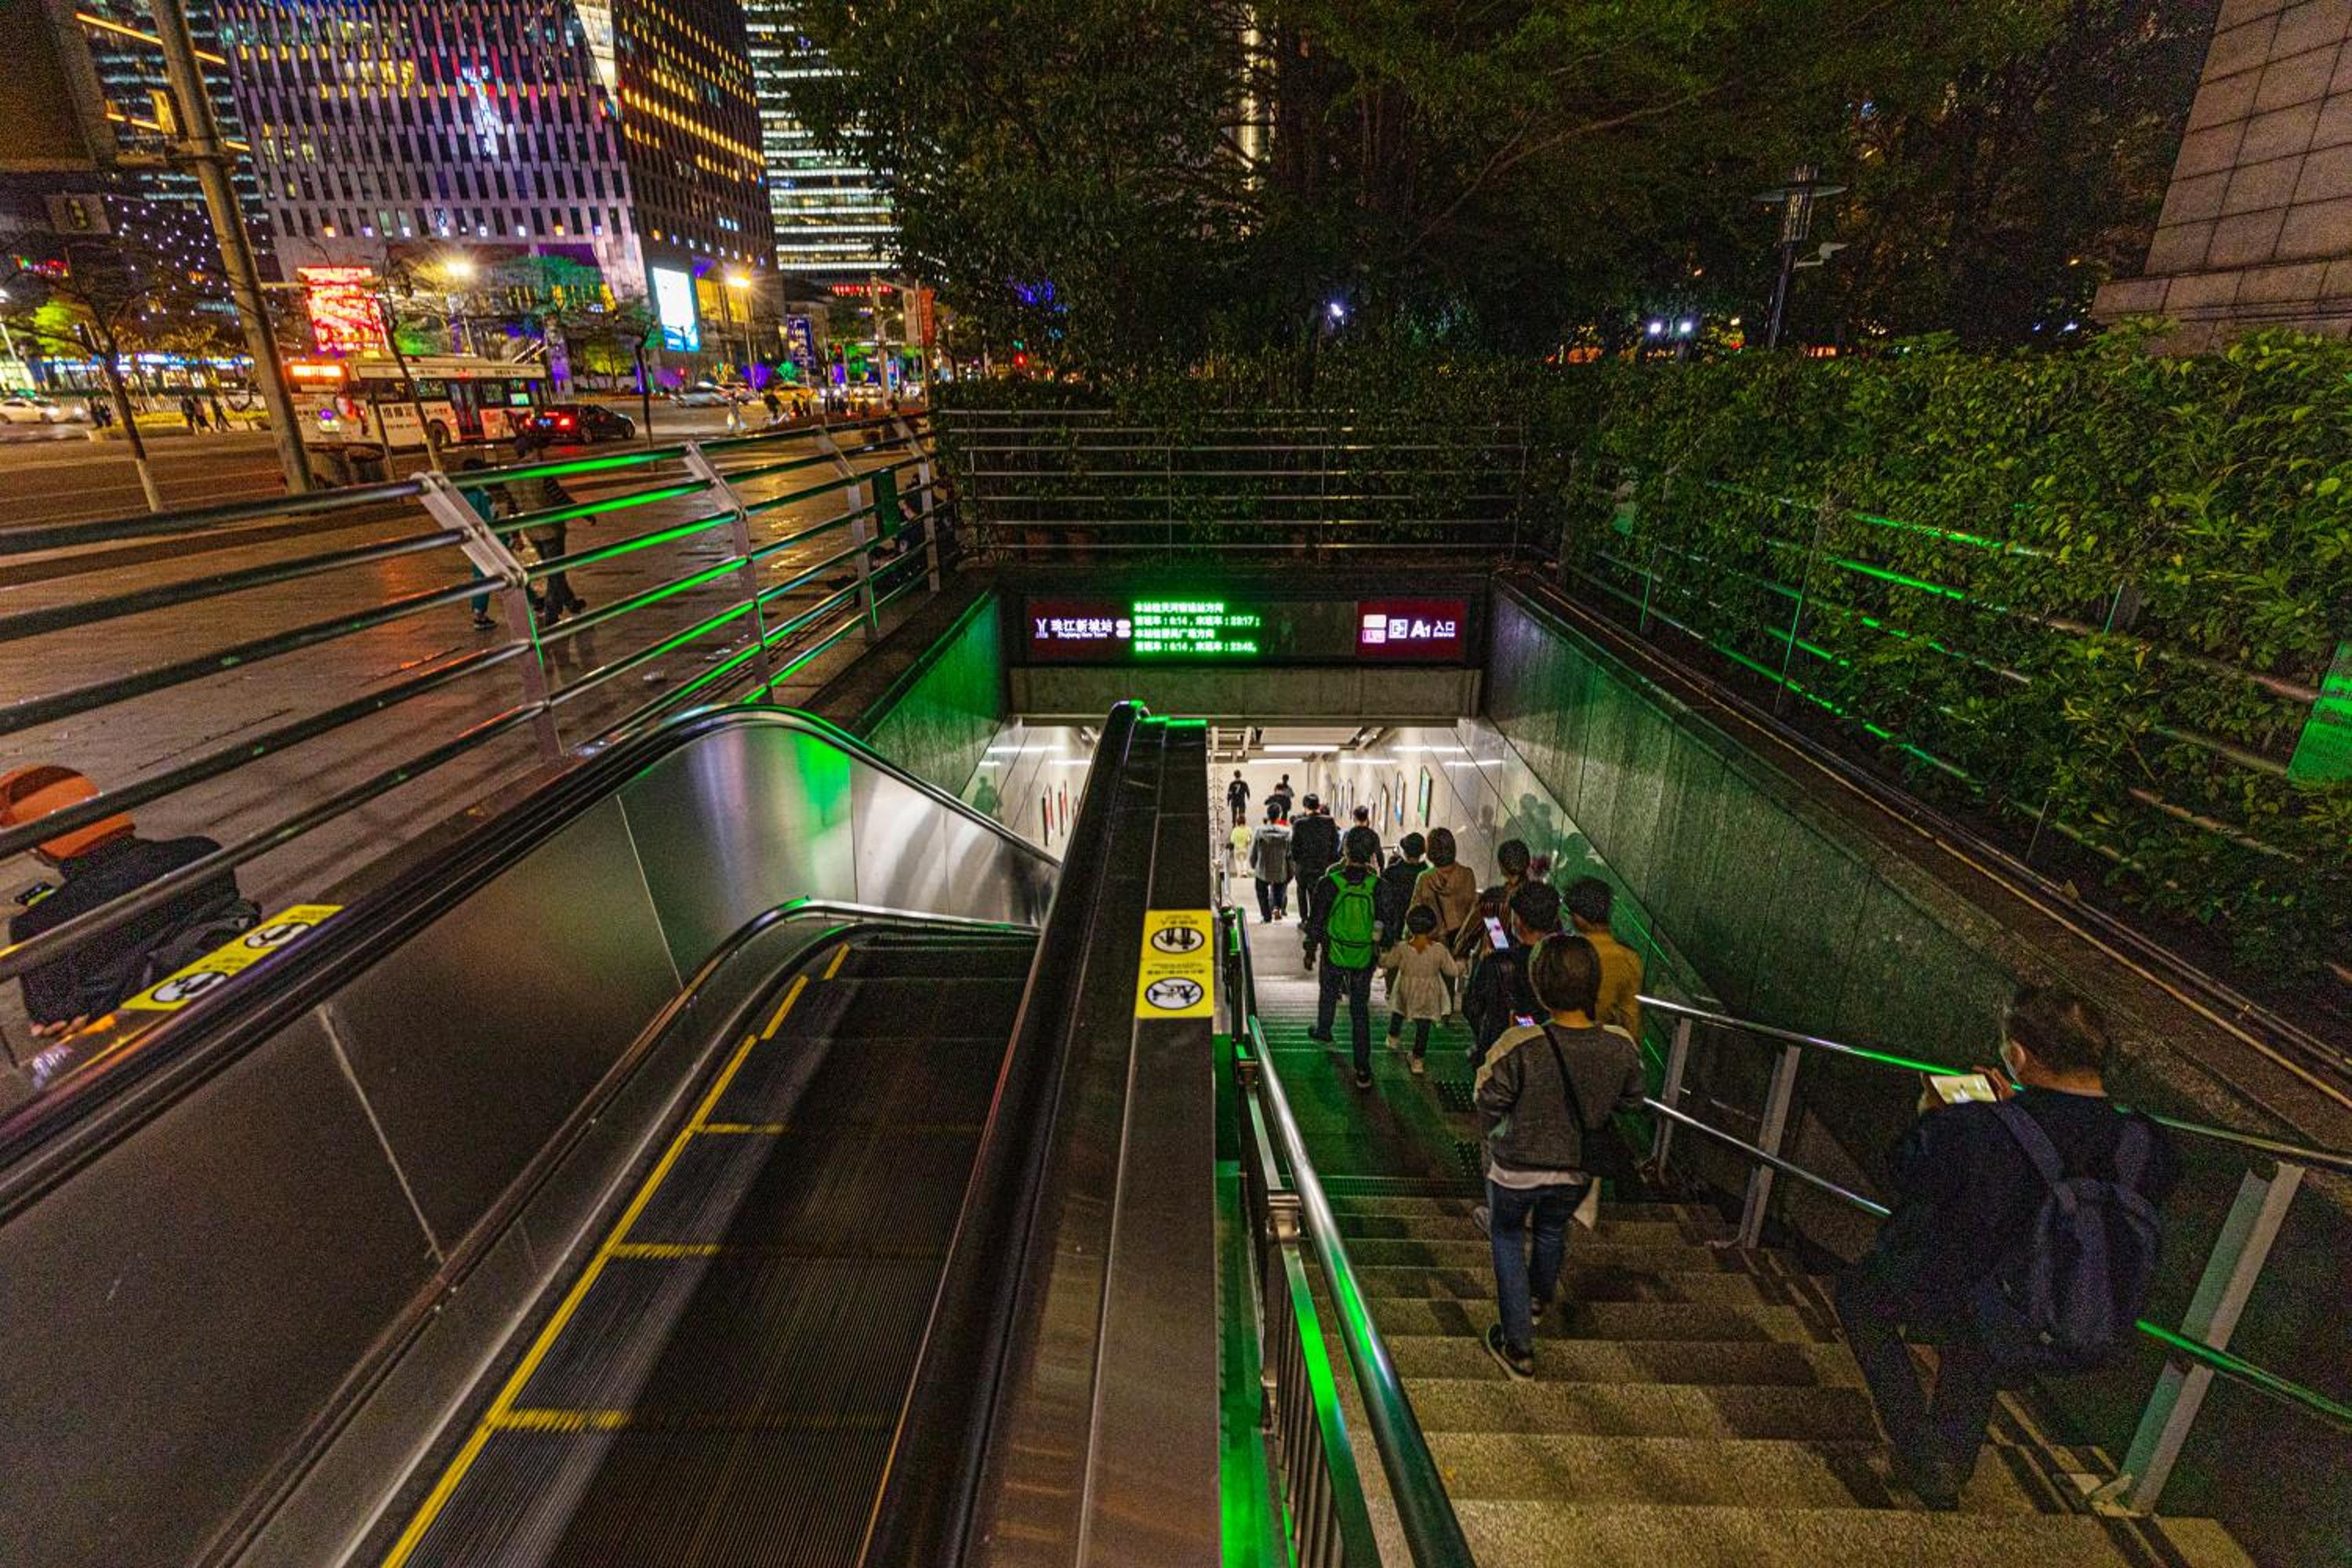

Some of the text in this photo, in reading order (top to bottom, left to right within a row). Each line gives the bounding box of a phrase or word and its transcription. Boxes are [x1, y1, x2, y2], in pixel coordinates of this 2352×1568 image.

[1051, 619, 1113, 632] 珠江新城站
[1410, 620, 1431, 637] A1
[1434, 620, 1455, 631] 入口
